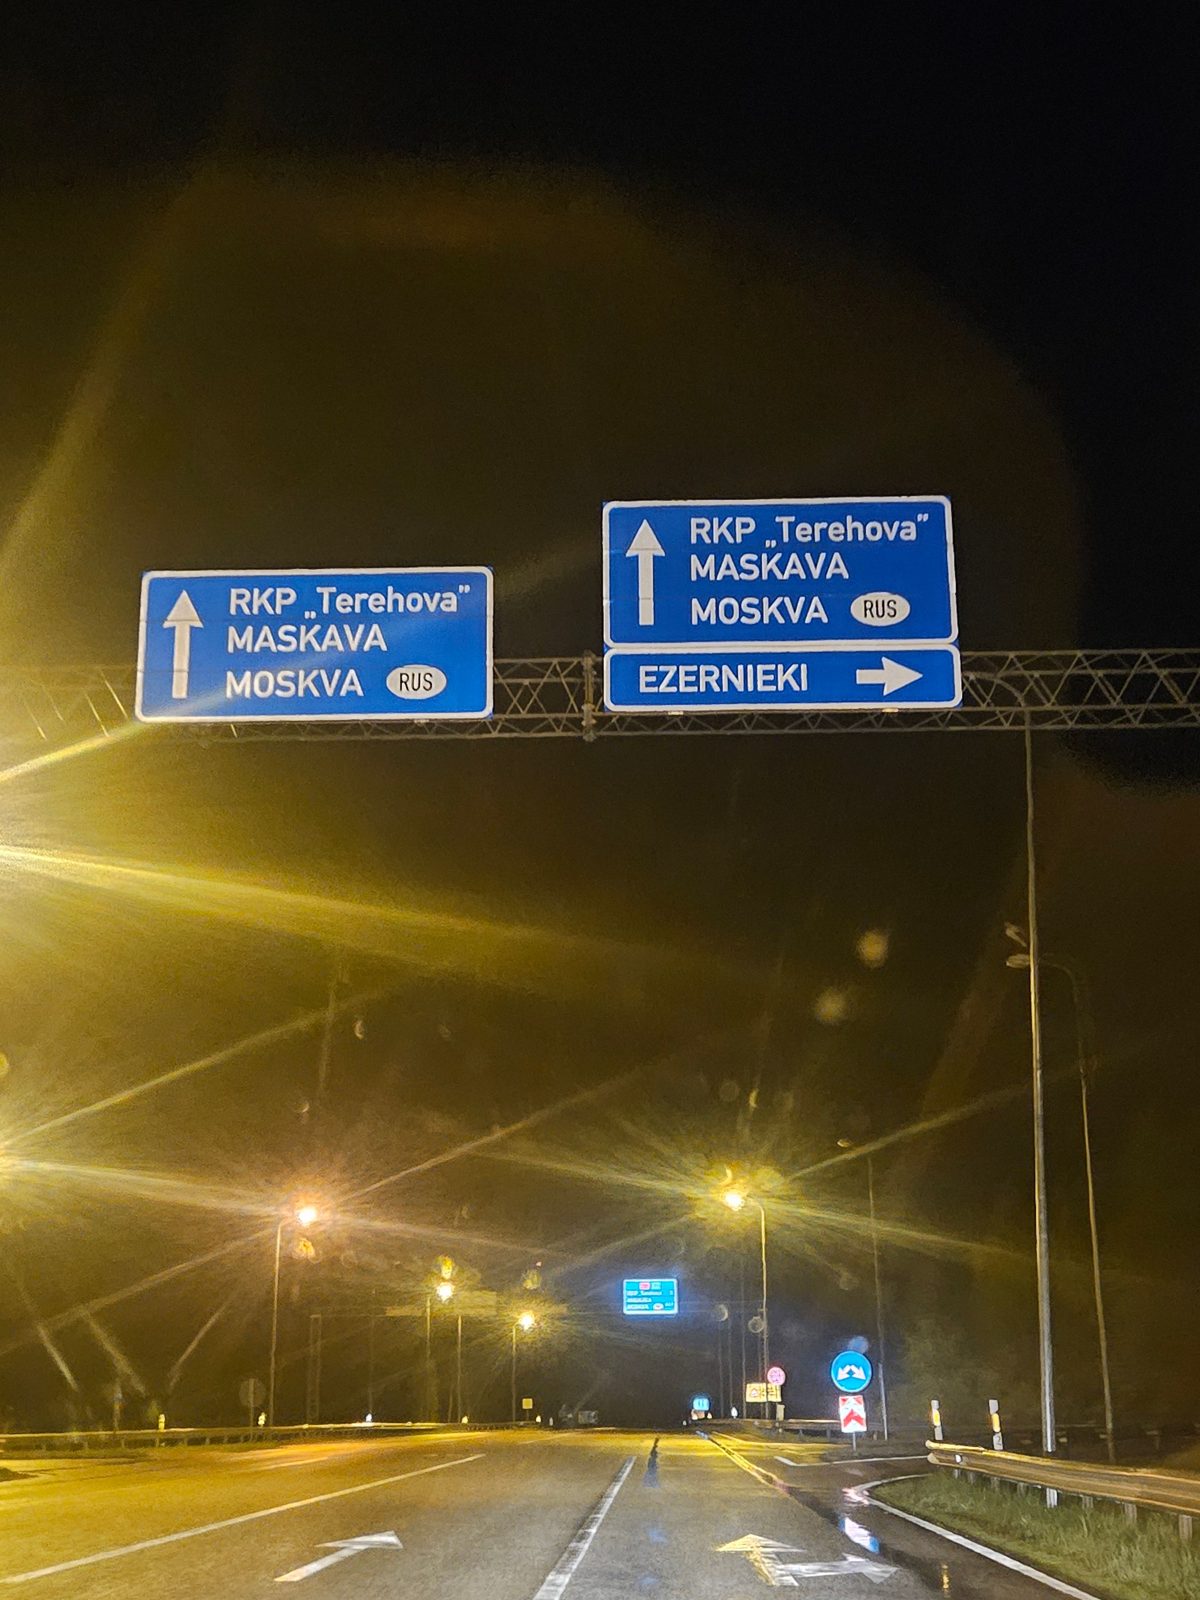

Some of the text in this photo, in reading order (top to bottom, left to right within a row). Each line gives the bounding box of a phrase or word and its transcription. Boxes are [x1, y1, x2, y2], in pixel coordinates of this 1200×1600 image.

[690, 517, 756, 545] RKP
[690, 552, 849, 581] MASKAVA
[229, 587, 297, 616] RKP
[691, 596, 828, 625] MOSKVA
[863, 599, 897, 619] RUS
[226, 624, 388, 653] MASKAVA
[225, 669, 365, 699] MOSKVA
[399, 672, 434, 692] RUS
[639, 663, 808, 693] EZERNIEKI
